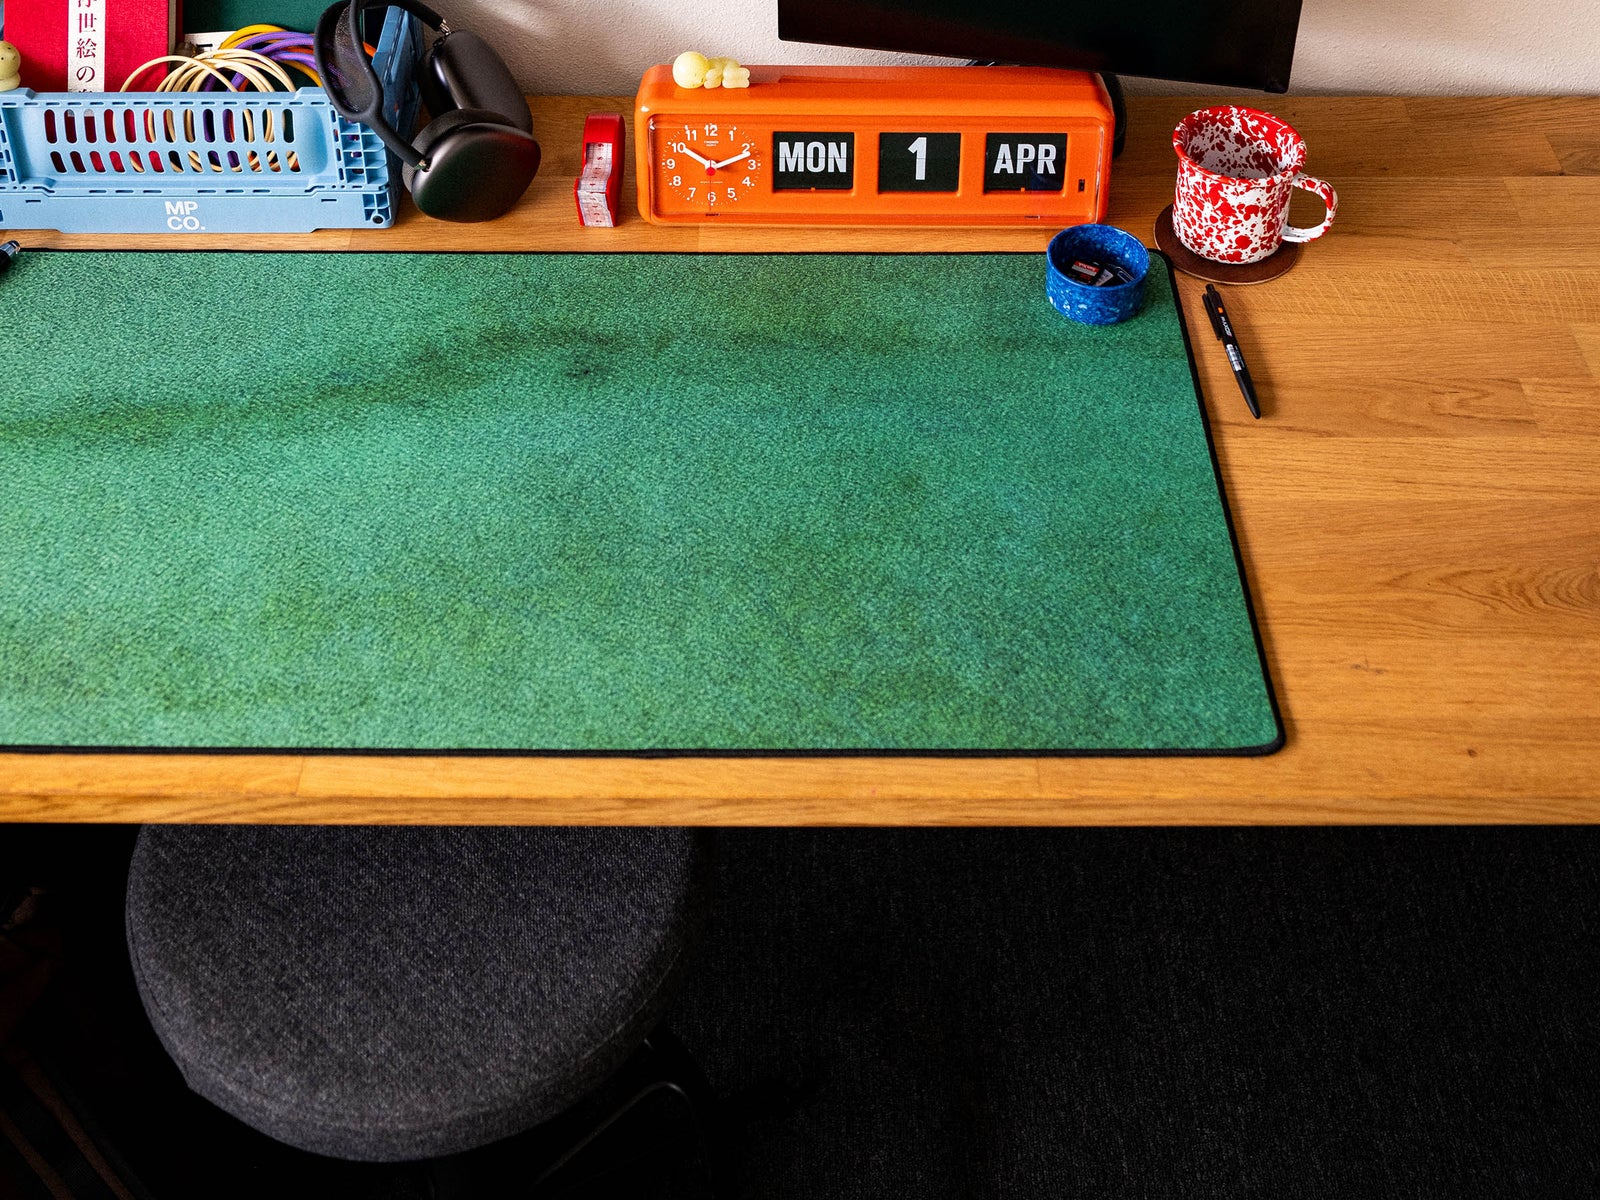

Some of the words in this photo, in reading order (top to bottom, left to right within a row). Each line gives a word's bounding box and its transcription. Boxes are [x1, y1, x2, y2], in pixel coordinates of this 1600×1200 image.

[686, 130, 697, 141] 11
[704, 124, 718, 136] 12
[728, 131, 734, 141] 1
[672, 142, 686, 153] 10
[741, 143, 751, 154] 2
[778, 141, 847, 173] MON
[907, 137, 927, 180] 1
[993, 143, 1057, 174] APR
[666, 159, 675, 169] 9
[747, 160, 756, 170] 3
[672, 176, 681, 186] 8
[742, 176, 751, 186] 4
[688, 188, 696, 197] 7
[707, 192, 716, 202] 6
[727, 188, 735, 198] 5
[165, 201, 198, 215] MP
[167, 216, 206, 231] CO.
